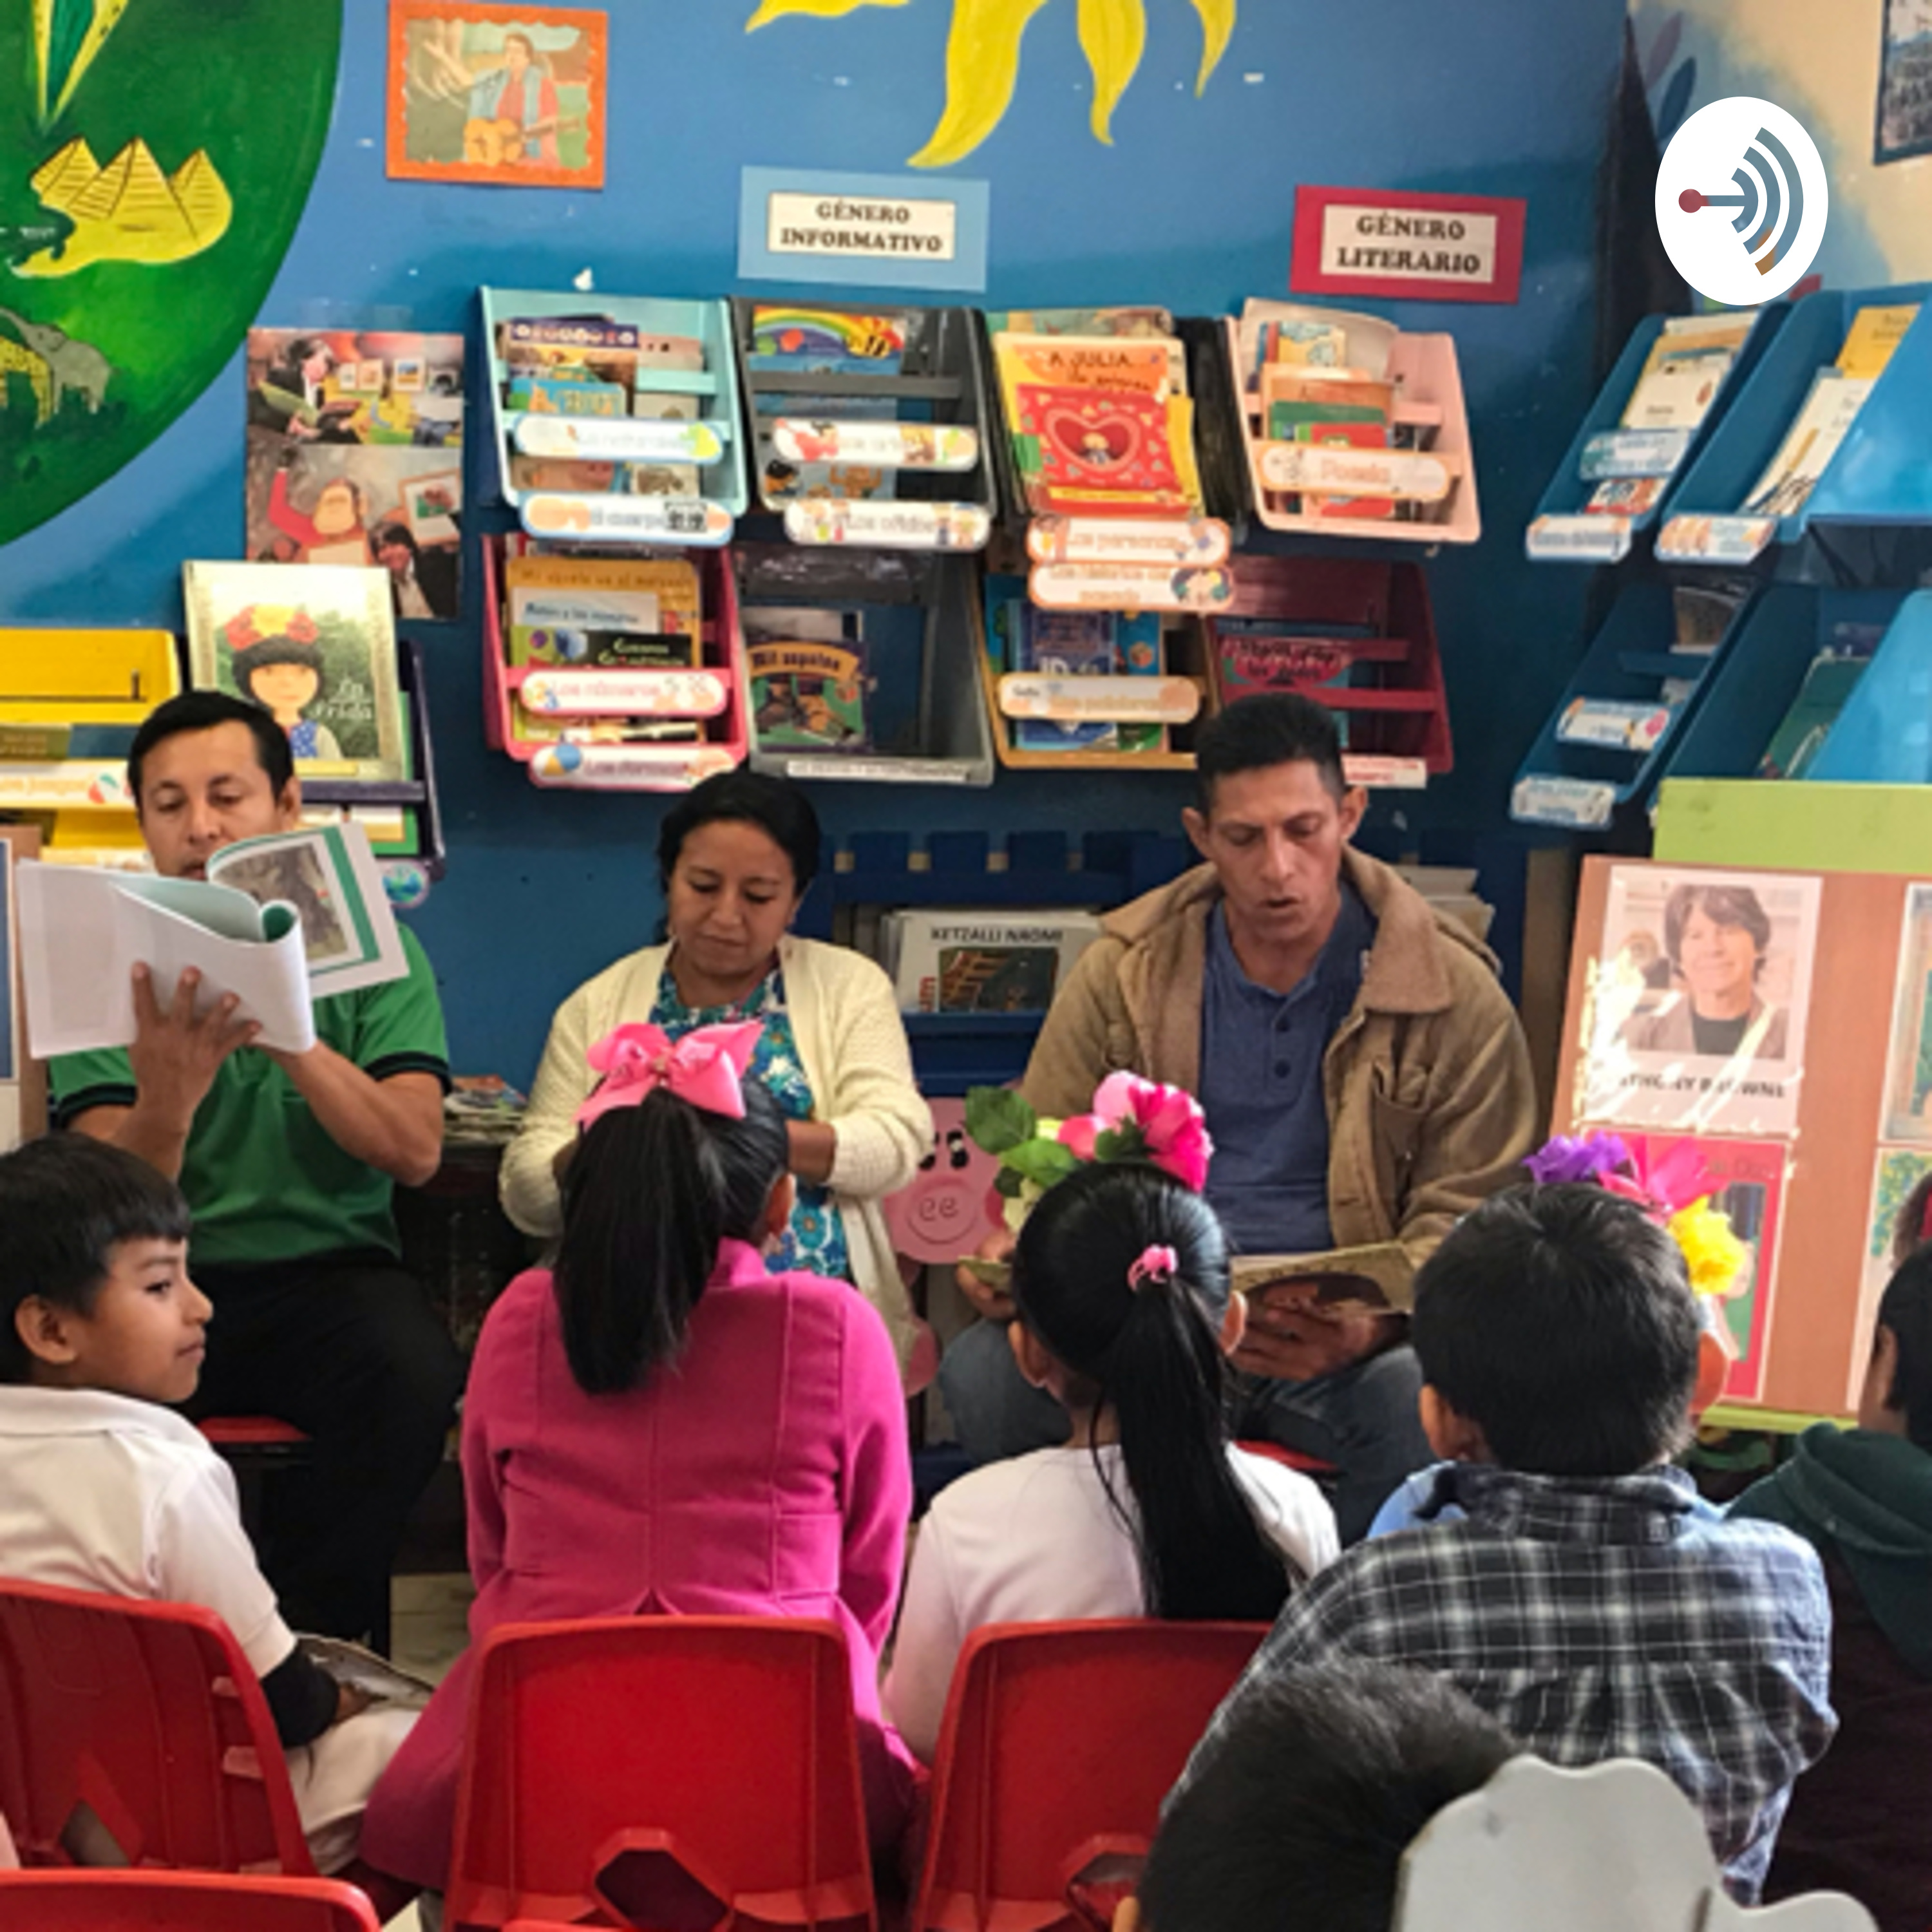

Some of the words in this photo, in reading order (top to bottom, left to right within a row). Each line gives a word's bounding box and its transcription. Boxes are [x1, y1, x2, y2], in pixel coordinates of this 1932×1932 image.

[816, 198, 910, 224] GÉNERO
[781, 226, 943, 253] INFORMATIVO
[1356, 211, 1466, 241] GÉNERO
[1336, 245, 1481, 275] LITERARIO
[1005, 928, 1064, 943] NAOMI
